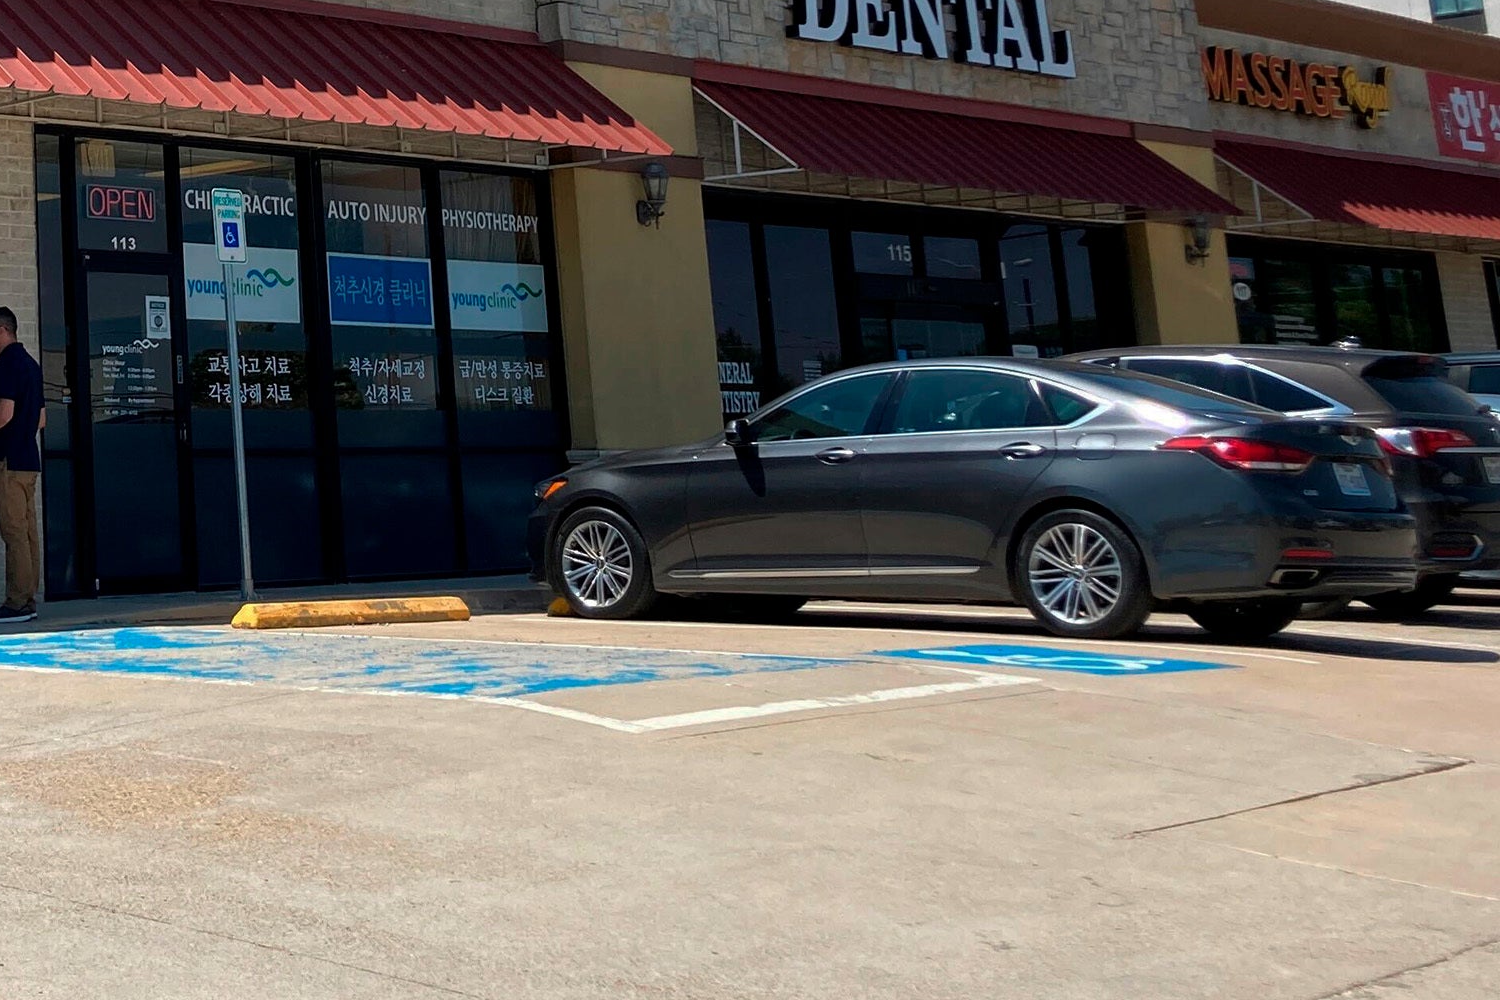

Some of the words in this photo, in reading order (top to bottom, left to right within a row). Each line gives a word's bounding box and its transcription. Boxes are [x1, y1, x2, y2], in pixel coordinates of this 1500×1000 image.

[1202, 45, 1346, 120] MASSAGE
[89, 187, 154, 220] OPEN
[184, 189, 295, 217] CHIRACTIC
[327, 200, 371, 222] AUTO
[373, 203, 426, 225] INJURY
[441, 208, 539, 234] PHYSIOTHERAPY
[111, 236, 137, 250] 113
[887, 244, 912, 262] 115
[333, 275, 385, 305] 척추신경
[388, 279, 427, 307] 클리닉
[264, 356, 291, 377] 치료
[266, 383, 293, 404] 치료
[364, 384, 414, 405] 신경치료
